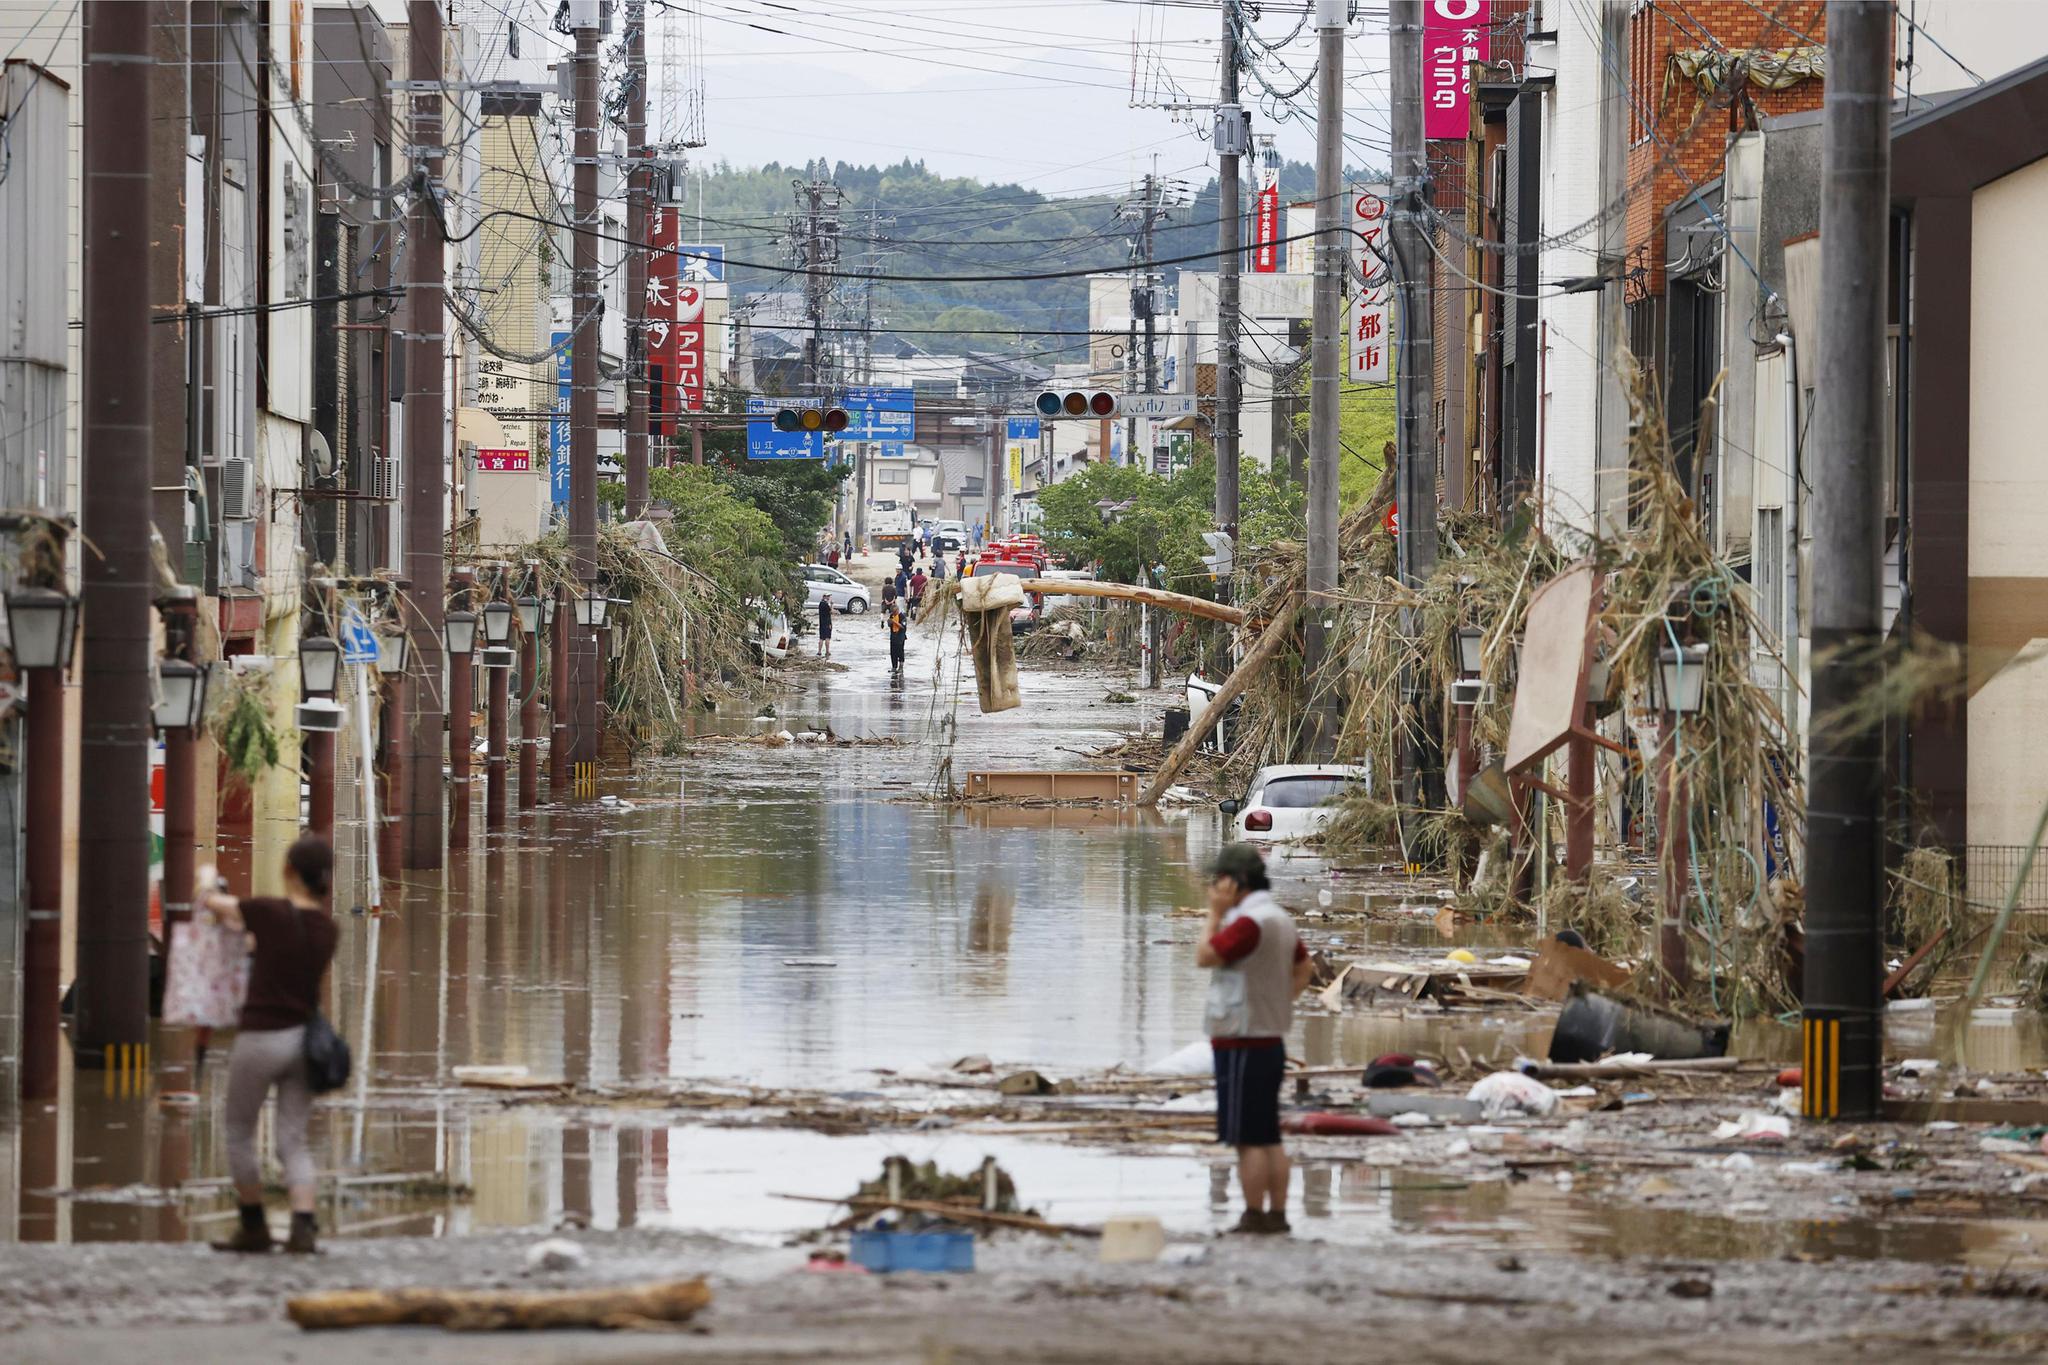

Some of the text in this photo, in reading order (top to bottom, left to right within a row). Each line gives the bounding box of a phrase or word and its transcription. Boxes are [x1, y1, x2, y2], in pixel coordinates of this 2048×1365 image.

[1357, 227, 1382, 371] アレン都市
[678, 330, 699, 388] アコム
